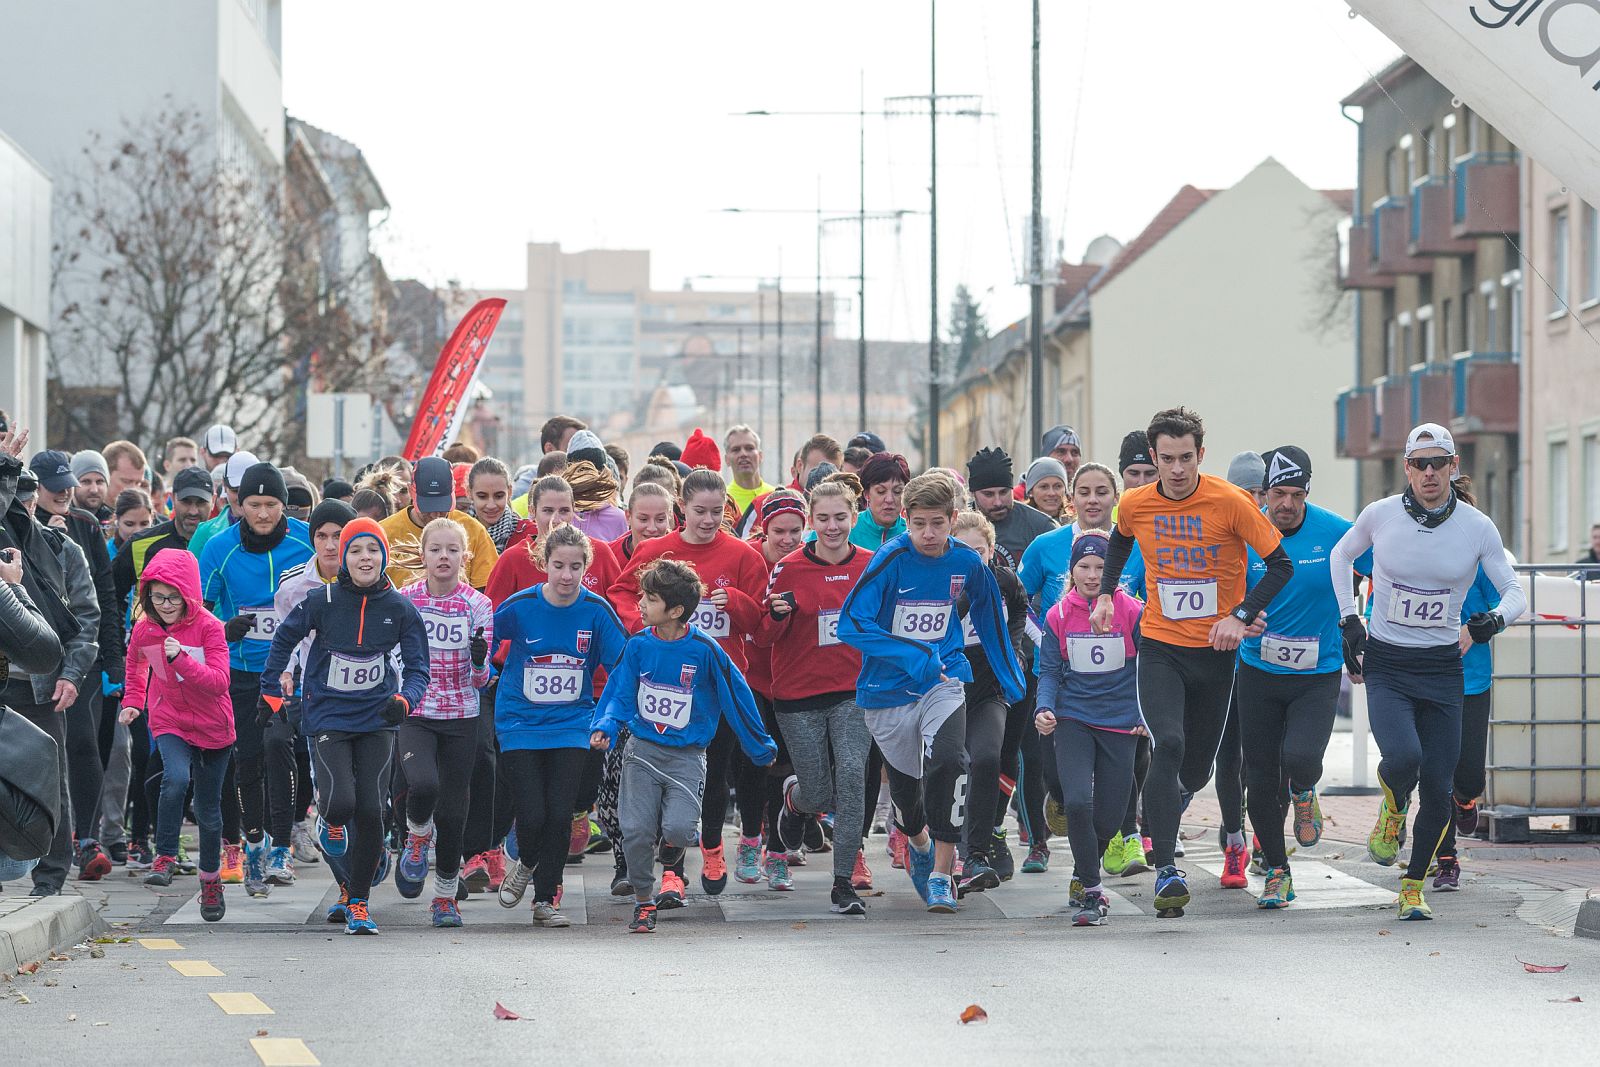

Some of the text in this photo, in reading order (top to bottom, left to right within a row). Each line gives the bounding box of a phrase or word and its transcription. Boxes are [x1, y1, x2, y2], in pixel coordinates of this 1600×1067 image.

[1154, 515, 1203, 541] RUN
[1155, 544, 1222, 573] FAST
[1173, 591, 1204, 612] 70
[1401, 599, 1444, 621] 142
[423, 619, 463, 643] 205
[688, 611, 725, 630] 295
[904, 612, 946, 633] 388
[1090, 645, 1105, 665] 6
[1277, 646, 1306, 664] 37
[340, 664, 381, 685] 180
[534, 675, 577, 695] 384
[644, 694, 687, 720] 387
